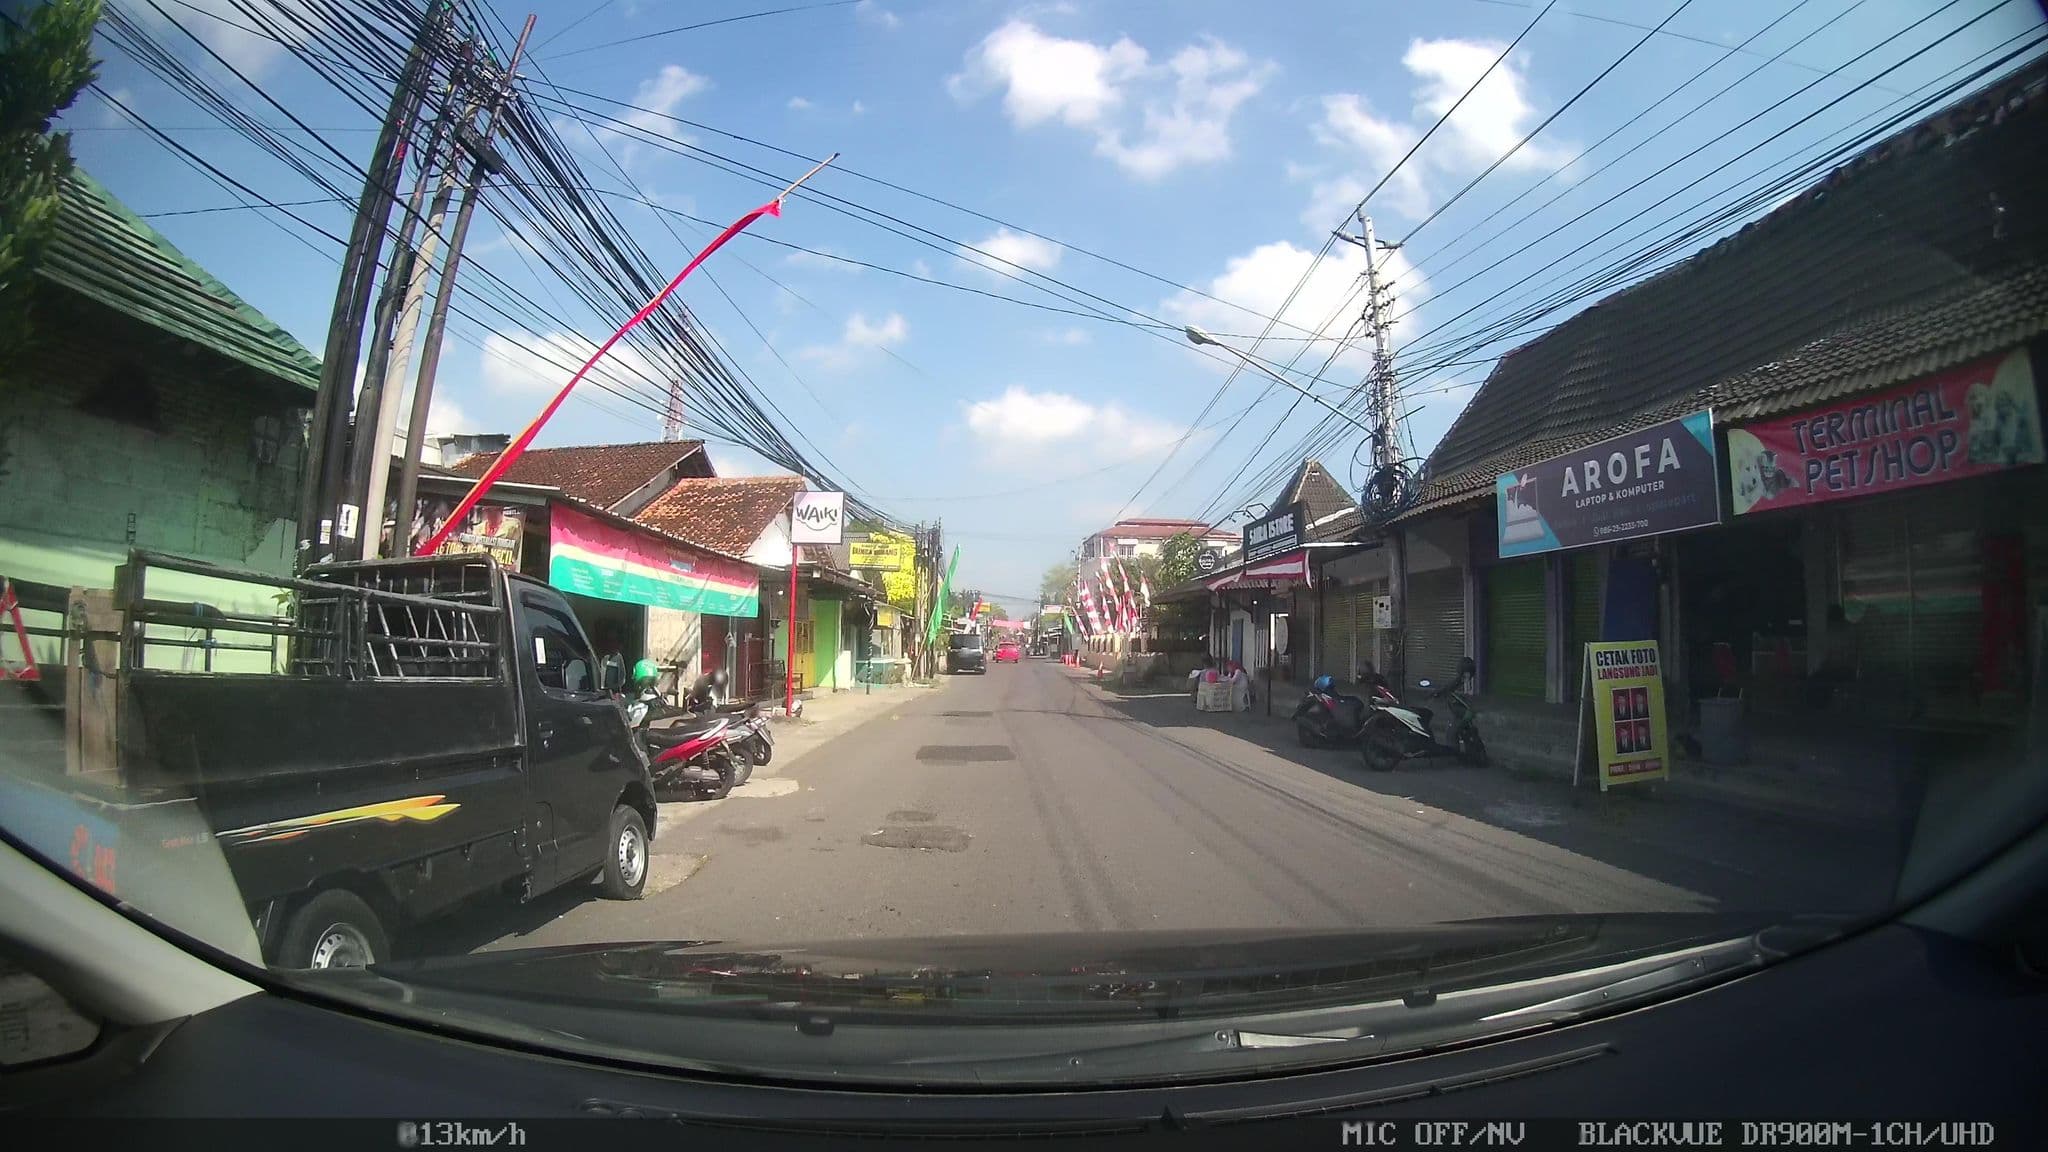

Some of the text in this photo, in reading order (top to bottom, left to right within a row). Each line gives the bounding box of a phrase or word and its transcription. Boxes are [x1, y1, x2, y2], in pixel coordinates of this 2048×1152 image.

[1792, 383, 1958, 454] TERMINAL
[1561, 437, 1681, 498] AROFA
[1575, 480, 1665, 509] LAPTOP & KOMPUTER
[1595, 647, 1656, 667] CETAK FOTO
[1597, 666, 1640, 681] LANGSUNG
